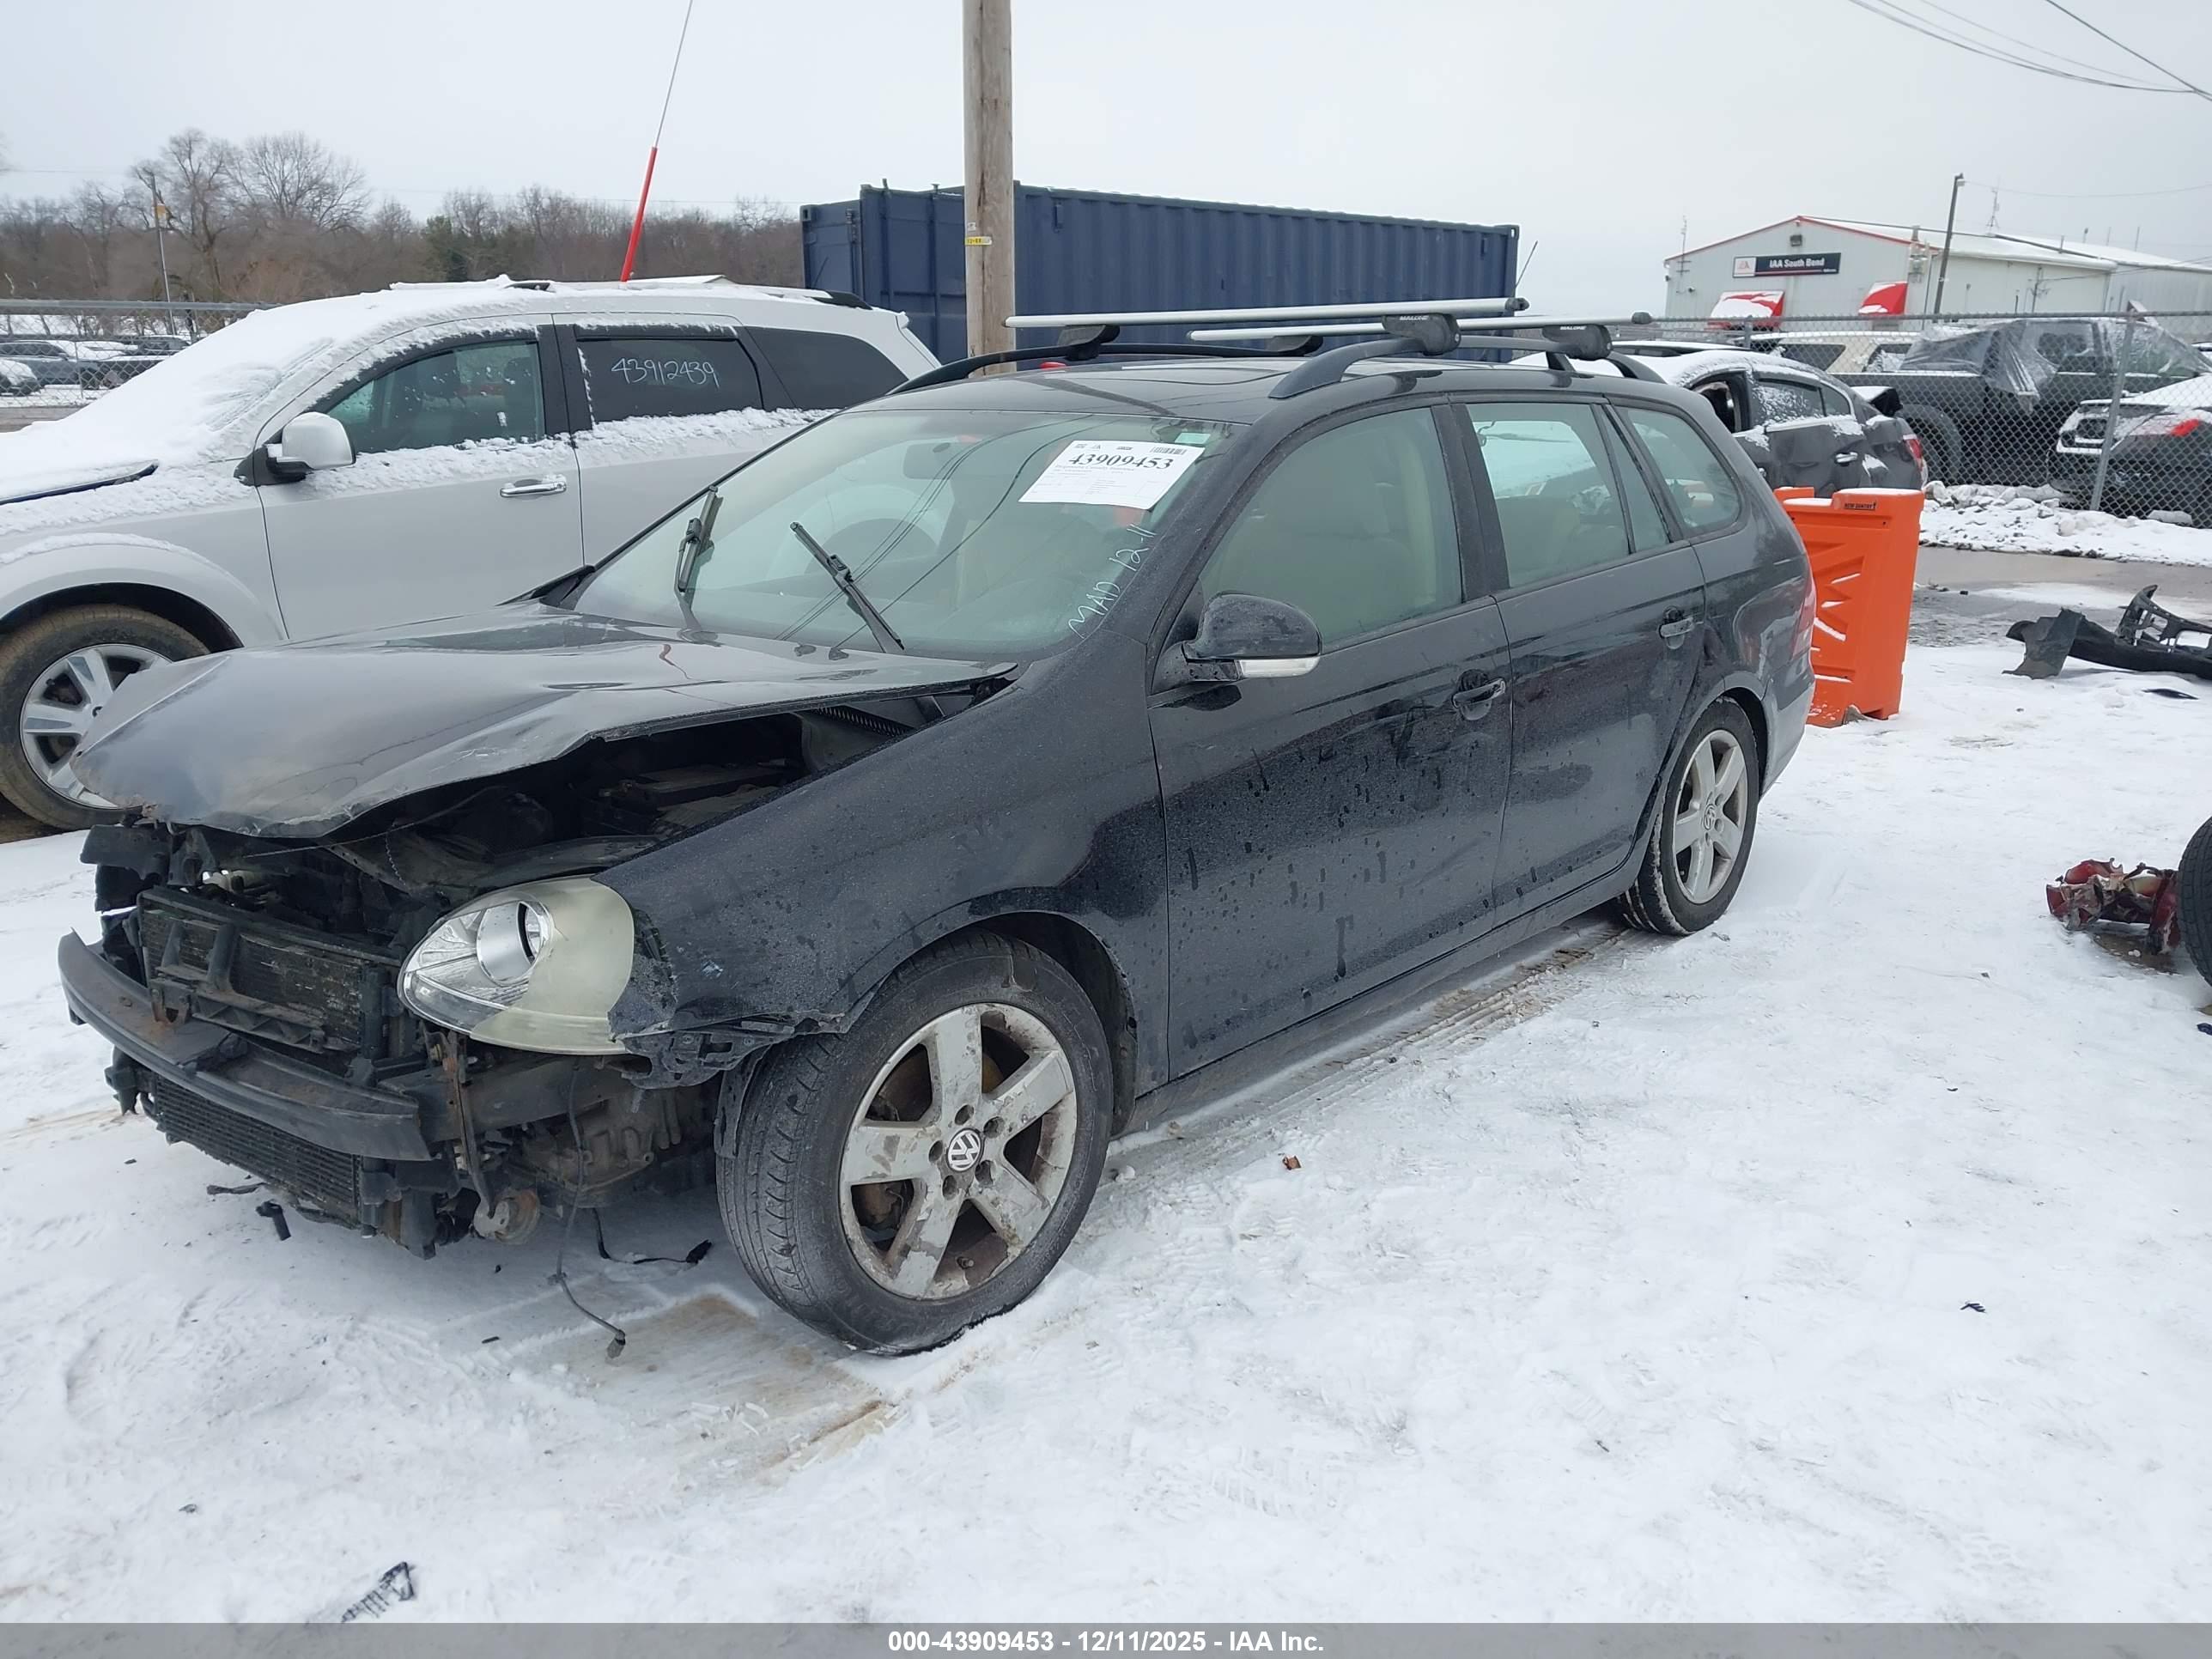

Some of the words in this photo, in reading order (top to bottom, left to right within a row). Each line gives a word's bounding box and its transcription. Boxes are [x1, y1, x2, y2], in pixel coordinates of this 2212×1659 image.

[1784, 258, 1804, 268] South
[1805, 258, 1825, 266] Bend
[611, 357, 720, 389] 43912439
[1068, 453, 1174, 470] 43909453
[1068, 581, 1121, 640] MAD
